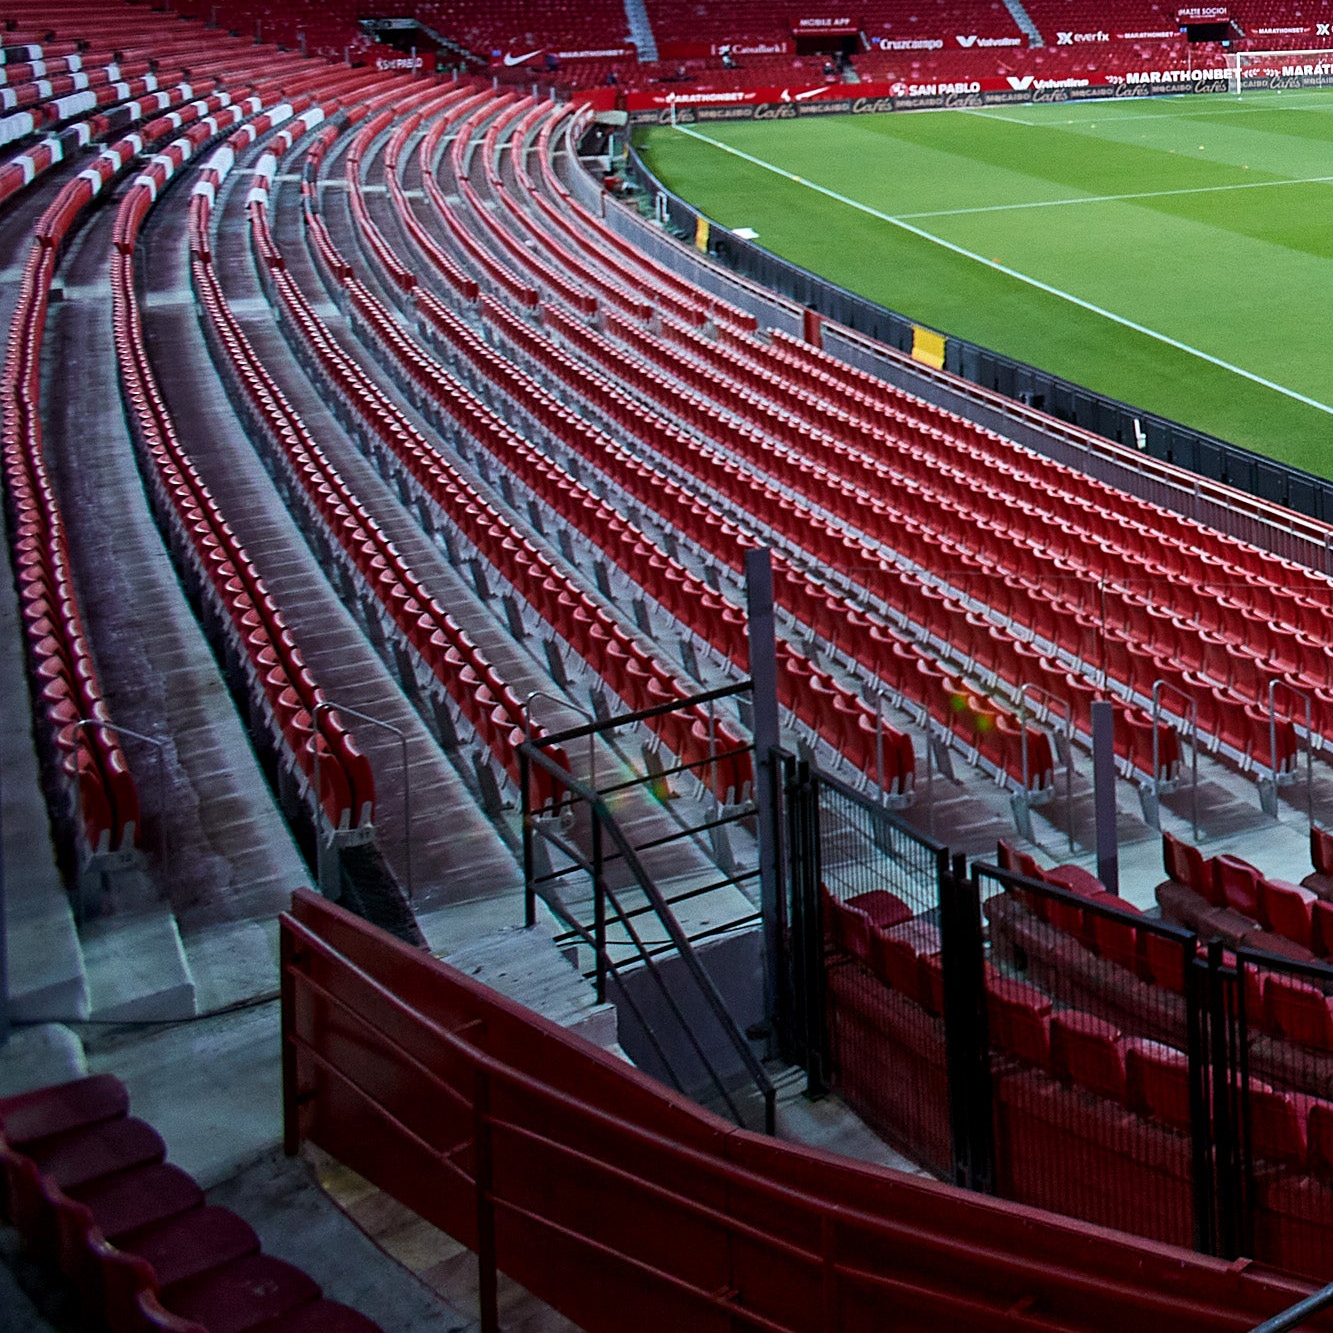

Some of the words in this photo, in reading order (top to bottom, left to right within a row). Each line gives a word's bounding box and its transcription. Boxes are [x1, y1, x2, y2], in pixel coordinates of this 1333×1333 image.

[1201, 7, 1227, 16] SOCIO!
[800, 18, 832, 26] MOBILE
[833, 17, 850, 26] APP
[976, 37, 1021, 48] Valvoline
[1074, 30, 1110, 42] everfx
[879, 38, 944, 51] Cruzcampo
[1126, 68, 1242, 84] MARATHONBET
[908, 84, 937, 97] SAN
[938, 82, 981, 95] PABLO
[1115, 83, 1150, 97] Cafés
[1194, 79, 1228, 93] Cafés
[1032, 88, 1068, 103] Cafés
[852, 97, 893, 113] Cafés
